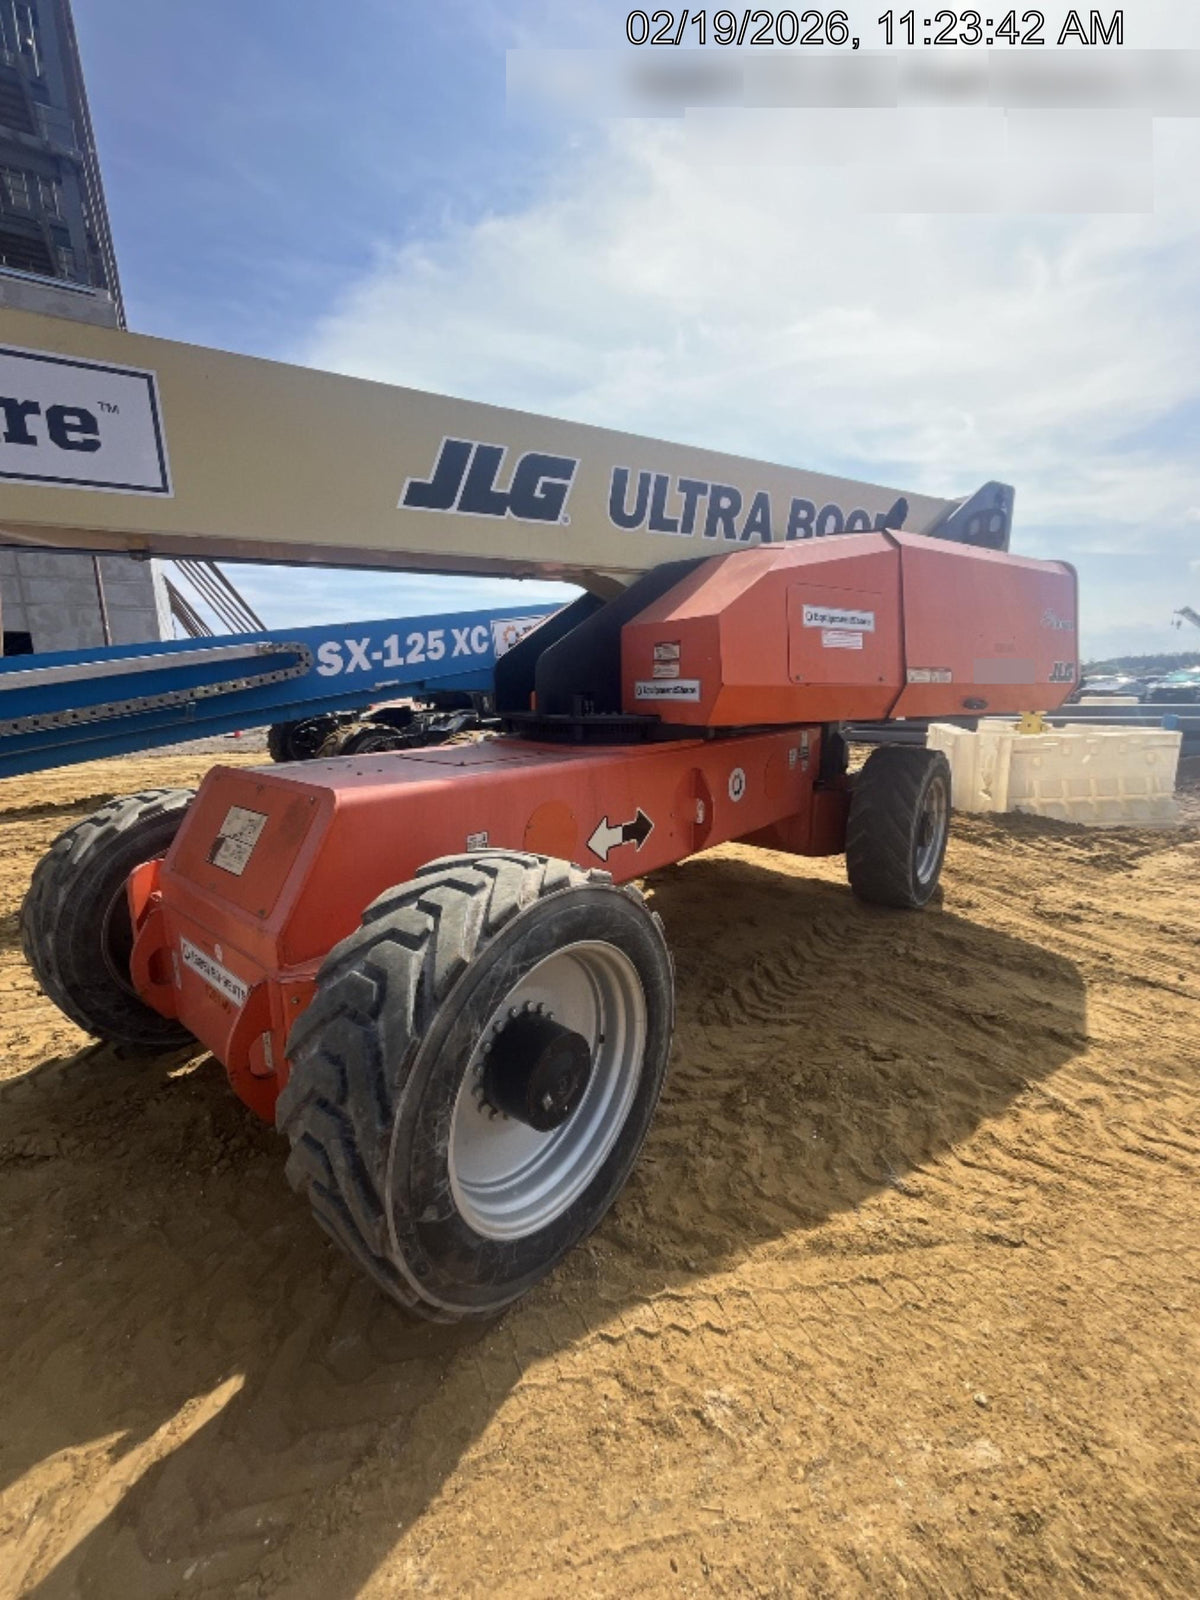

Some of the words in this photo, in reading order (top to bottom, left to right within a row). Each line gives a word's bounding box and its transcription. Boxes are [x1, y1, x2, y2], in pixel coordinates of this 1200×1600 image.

[397, 434, 581, 525] JLG
[608, 466, 773, 543] ULTRA
[316, 628, 446, 676] SX-125
[451, 624, 489, 657] XC
[1048, 661, 1077, 683] JLG
